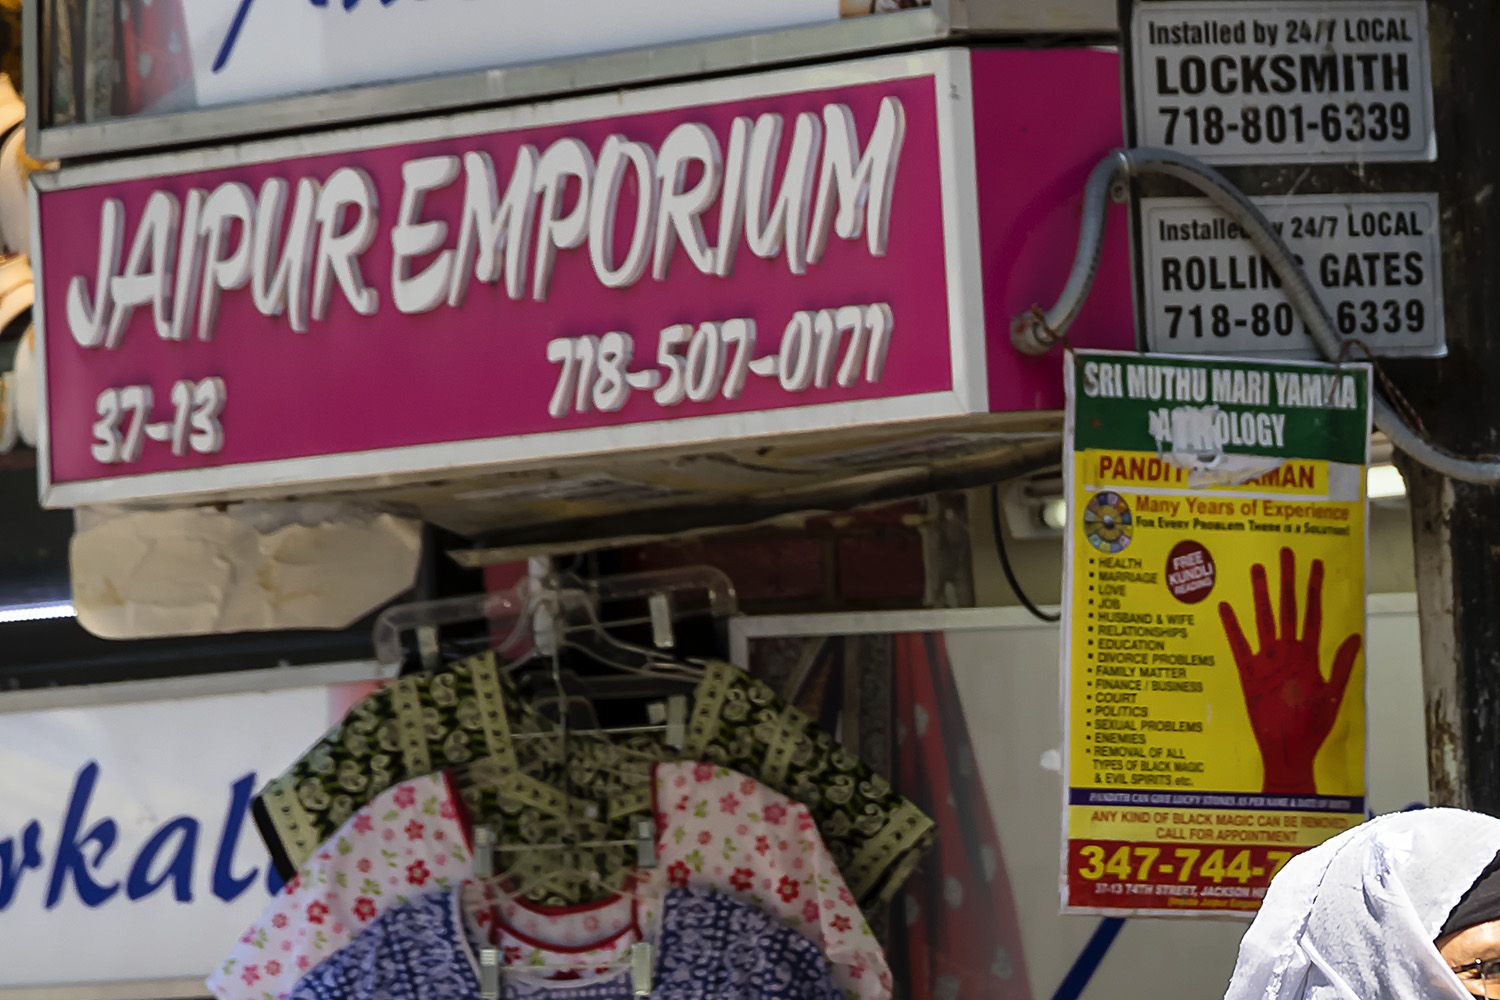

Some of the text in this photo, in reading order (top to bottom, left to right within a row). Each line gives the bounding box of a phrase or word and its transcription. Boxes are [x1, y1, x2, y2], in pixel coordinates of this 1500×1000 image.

[1149, 17, 1413, 47] Installed by 24/7 LOCAL
[1155, 53, 1410, 96] LOCKSMITH
[1158, 102, 1411, 146] 718-801-6339
[67, 96, 906, 350] JAIPUR EMPORIUM
[1290, 216, 1339, 239] 24/7
[1348, 211, 1424, 238] LOCAL
[1161, 251, 1424, 292] ROLLIN GATES
[1164, 299, 1425, 339] 718-806339
[547, 302, 893, 418] 718-507-0171
[1083, 361, 1123, 398] SRI
[1127, 364, 1207, 402] MUTHU
[1211, 369, 1270, 406] MARI
[91, 376, 227, 465] 37-13
[1154, 406, 1286, 448] AOLOGY
[1136, 495, 1350, 520] Many Years of Experience
[1098, 558, 1142, 569] HEALTH
[1098, 571, 1158, 584] MARRIAGE
[1098, 585, 1126, 597] LOVE
[1098, 599, 1121, 610] JOB
[1098, 612, 1195, 626] HUSBAND & WIFE
[1098, 625, 1188, 639] RELATIONSHIPS
[1098, 638, 1165, 651] EDUCATION
[1098, 652, 1215, 667] DIVORCE PROBLEMS
[1096, 665, 1186, 679] FAMILY MATTER
[1095, 679, 1142, 691] FINANCE
[1151, 680, 1204, 693] BUSINESS
[1095, 692, 1138, 704] COURT
[1095, 705, 1148, 717] POLITICS
[1094, 719, 1203, 733] SEXUAL PROBLEMS
[1094, 732, 1146, 745] ENEMIES
[1094, 746, 1186, 760] REMOVAL OF ALL
[1093, 759, 1204, 773] TYPES OF BLACK MAGIC
[1094, 773, 1103, 785] &
[1105, 773, 1129, 785] EVIL
[1131, 774, 1171, 786] SPIRITS
[1091, 810, 1118, 822] ANY
[1122, 812, 1150, 823] KIND
[1153, 812, 1169, 824] OF
[1173, 813, 1213, 825] BLACK
[1216, 814, 1255, 826] MAGIC
[1258, 815, 1280, 827] CAN
[1284, 815, 1298, 827] BE
[0, 759, 285, 911] rkal
[1156, 827, 1298, 842] CALL FOR APPOINTMENT
[1079, 845, 1293, 883] 347-744-7
[1200, 885, 1250, 898] JACKSON
